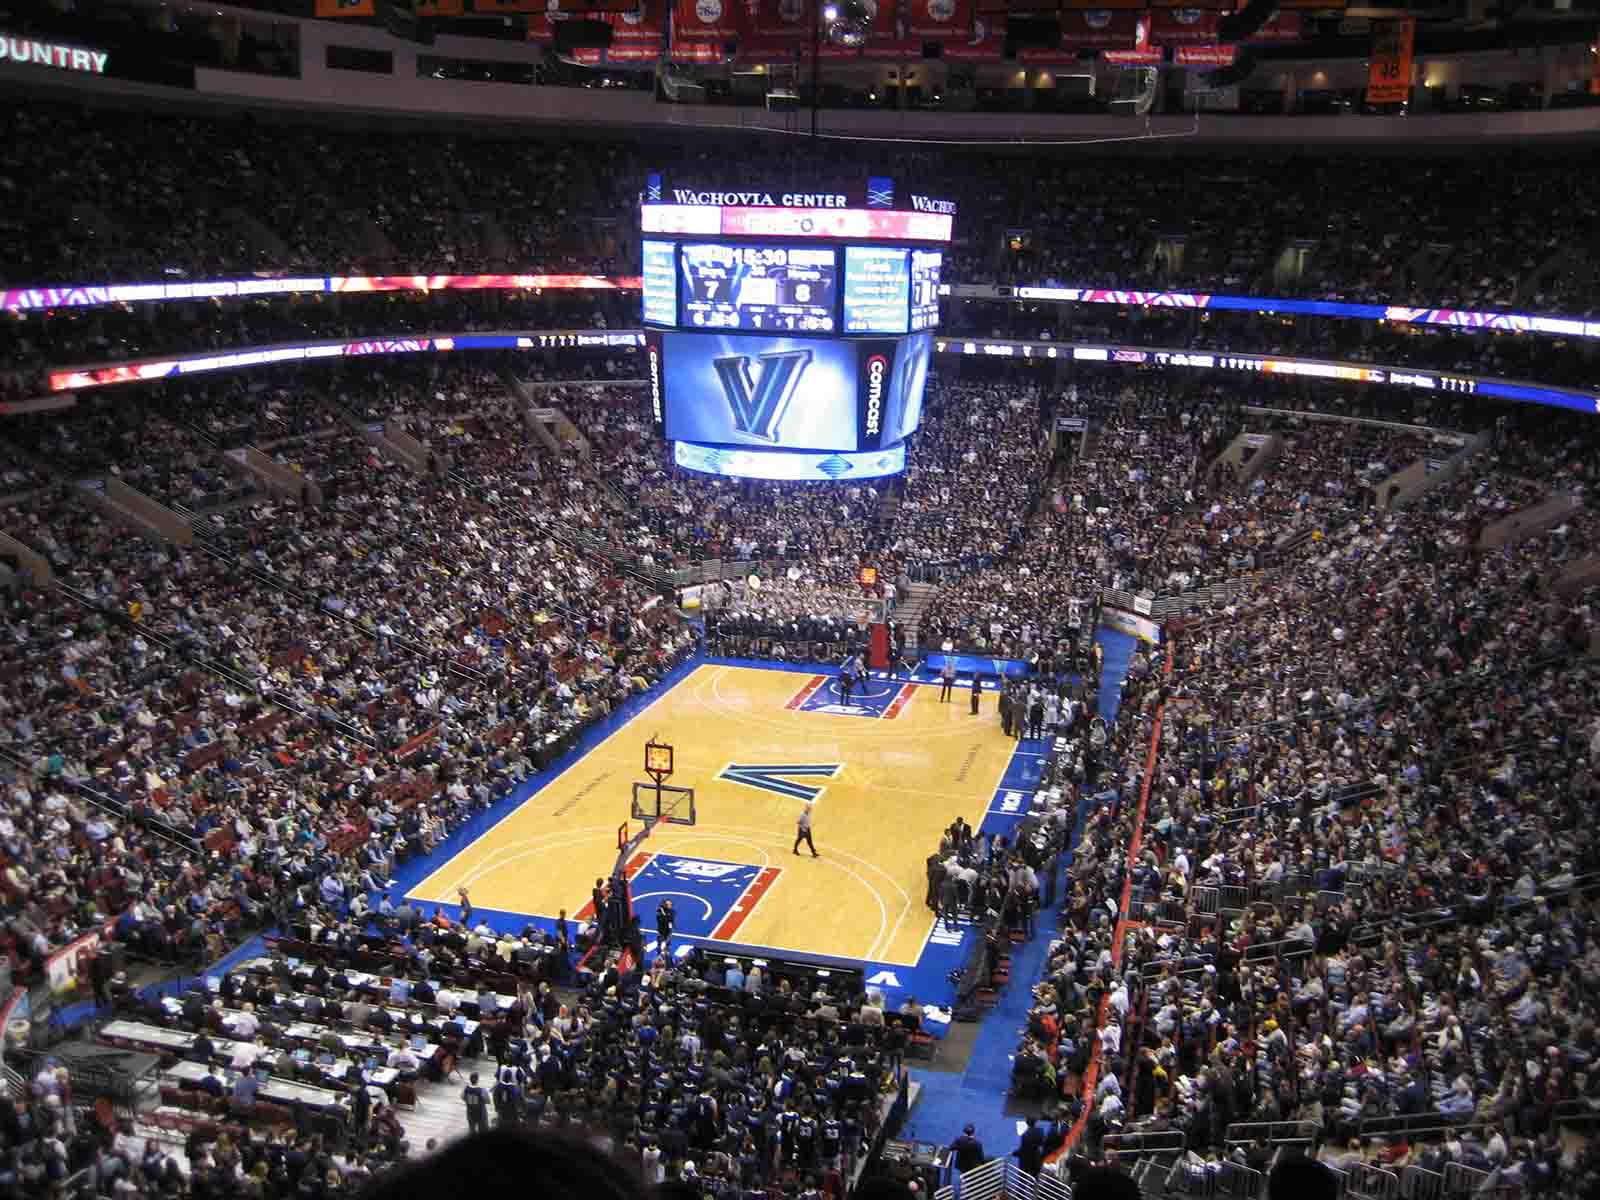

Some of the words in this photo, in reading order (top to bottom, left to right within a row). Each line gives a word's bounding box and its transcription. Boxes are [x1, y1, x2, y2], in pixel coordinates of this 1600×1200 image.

[672, 189, 775, 207] WACHOVIA
[782, 193, 847, 208] CENTER
[703, 280, 720, 298] 7
[711, 349, 816, 443] V
